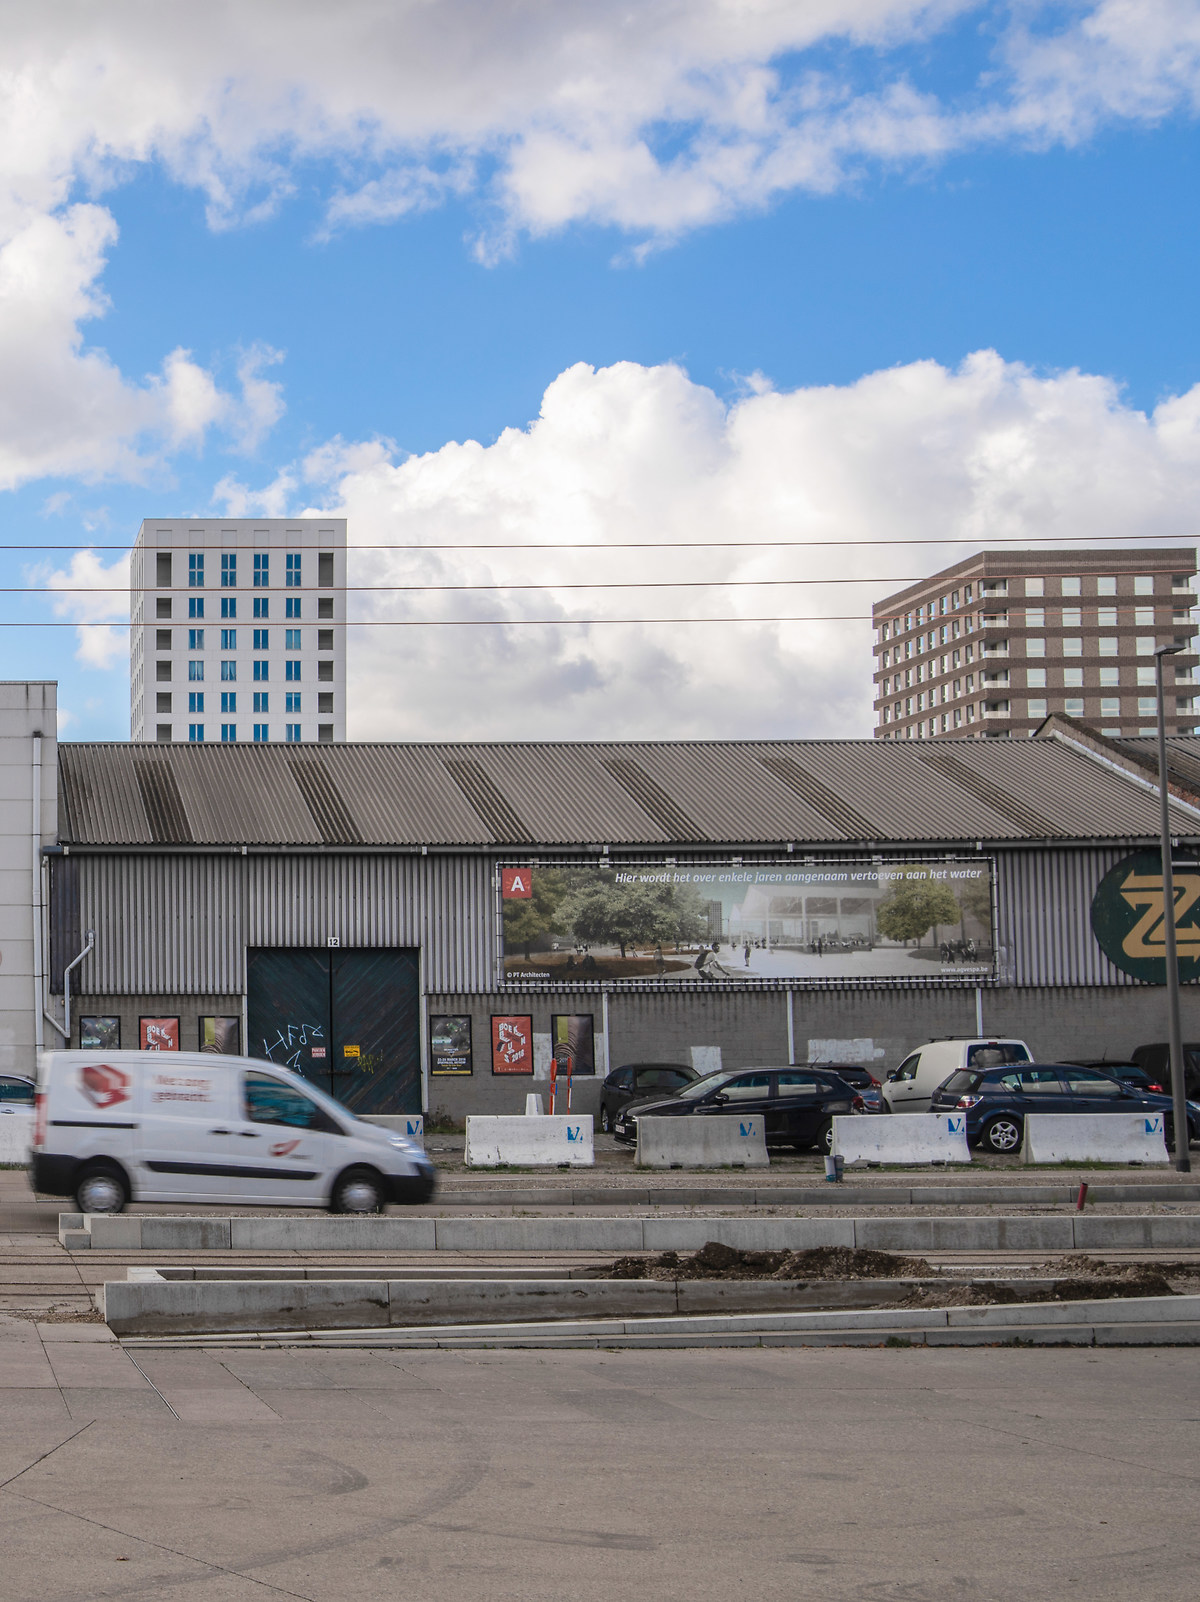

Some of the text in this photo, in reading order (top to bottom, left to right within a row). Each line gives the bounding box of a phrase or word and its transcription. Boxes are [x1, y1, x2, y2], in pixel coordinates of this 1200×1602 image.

[615, 869, 982, 883] Hier wordt het over enkele jaren aangenaam vertoeven aan het water
[511, 876, 525, 892] A
[329, 938, 338, 946] 12
